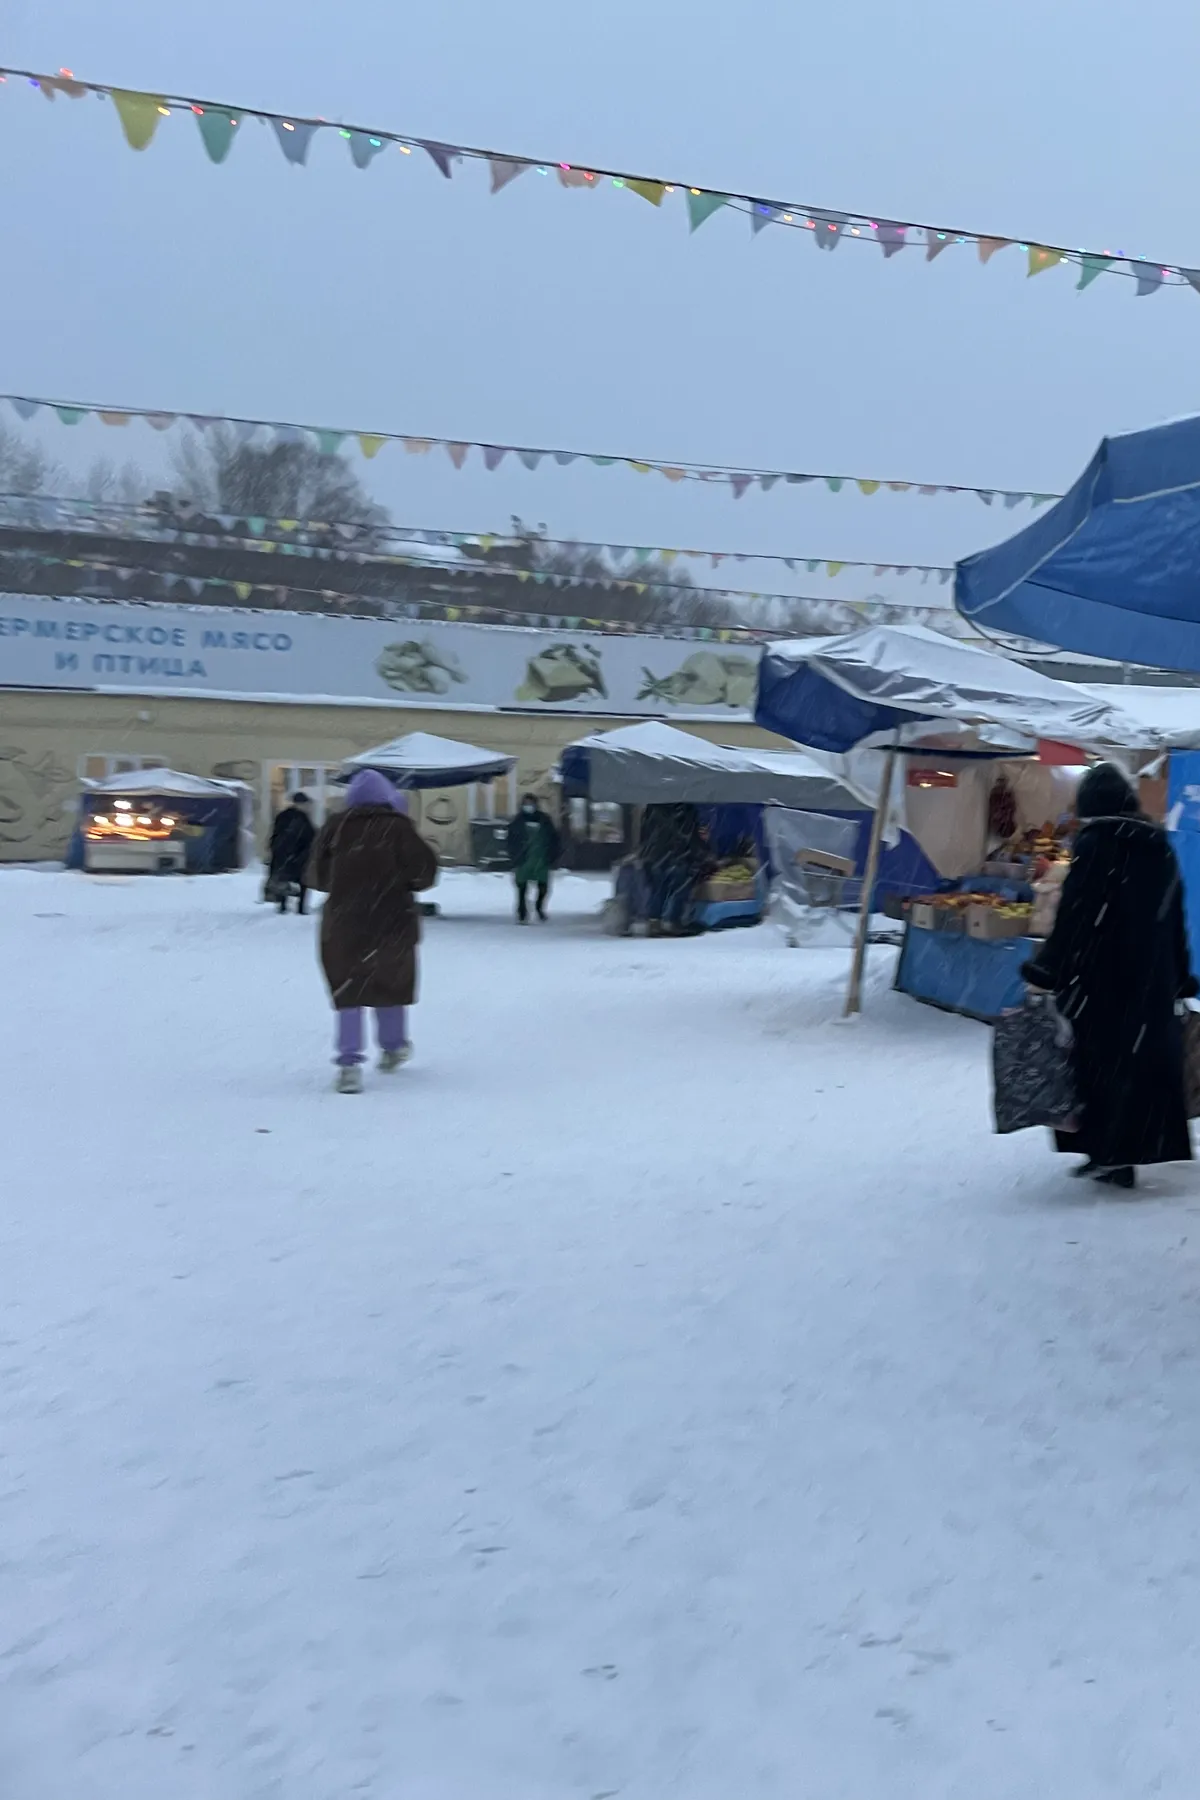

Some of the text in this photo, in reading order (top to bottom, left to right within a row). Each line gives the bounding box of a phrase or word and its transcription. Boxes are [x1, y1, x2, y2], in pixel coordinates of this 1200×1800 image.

[200, 629, 294, 651] МЯСО
[55, 651, 208, 678] И ПТИЦА
